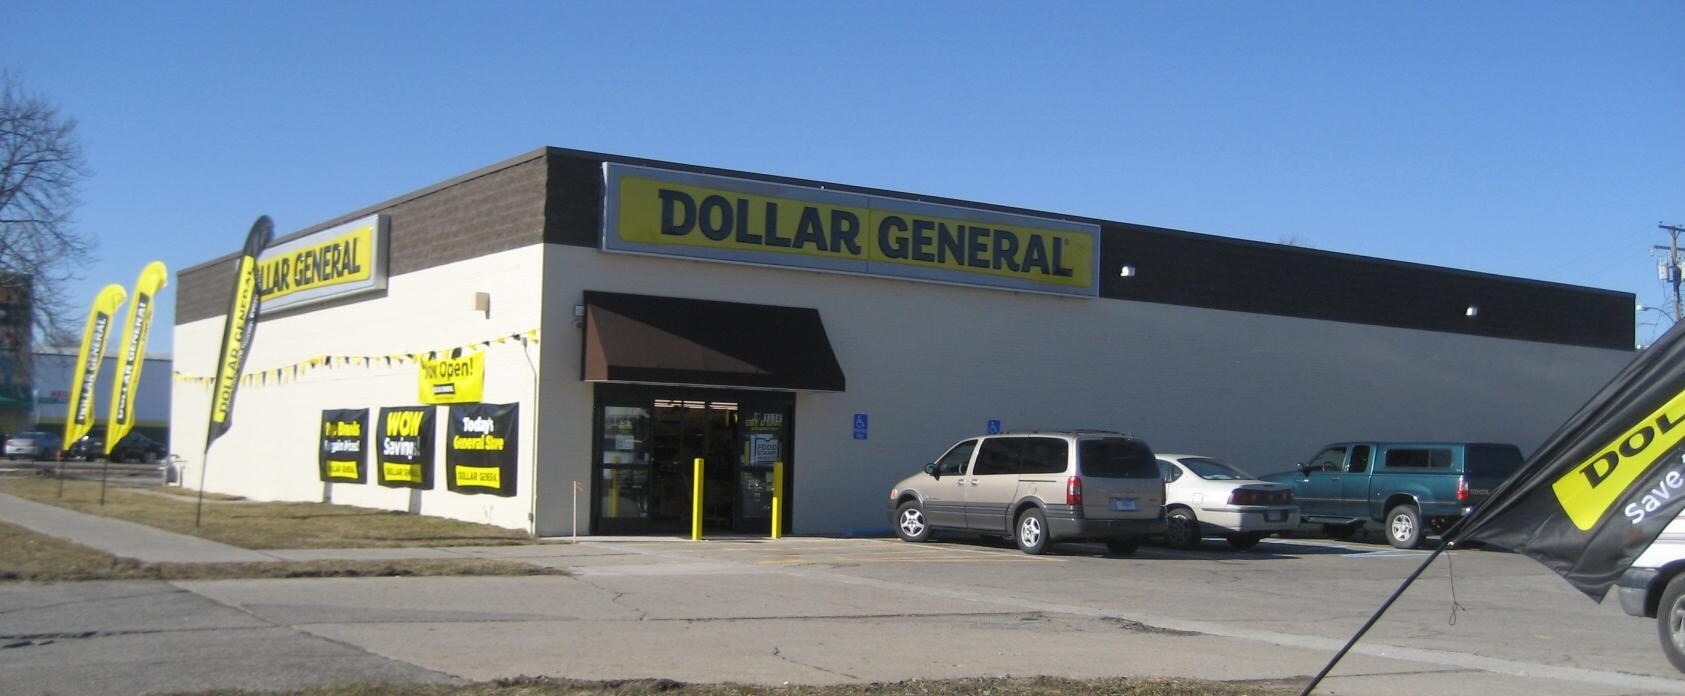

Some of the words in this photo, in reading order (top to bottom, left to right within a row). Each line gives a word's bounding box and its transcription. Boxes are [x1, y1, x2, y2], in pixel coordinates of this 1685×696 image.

[658, 188, 862, 255] DOLLAR
[877, 215, 1074, 278] GENERAL
[294, 237, 361, 287] GENERAL
[89, 318, 107, 371] GENERAL
[128, 302, 147, 360] GENERAL
[220, 349, 240, 414] DOLLAR
[439, 357, 473, 381] Open!
[386, 411, 424, 437] WOW
[457, 471, 478, 481] DOLLAR
[1624, 471, 1684, 524] Save
